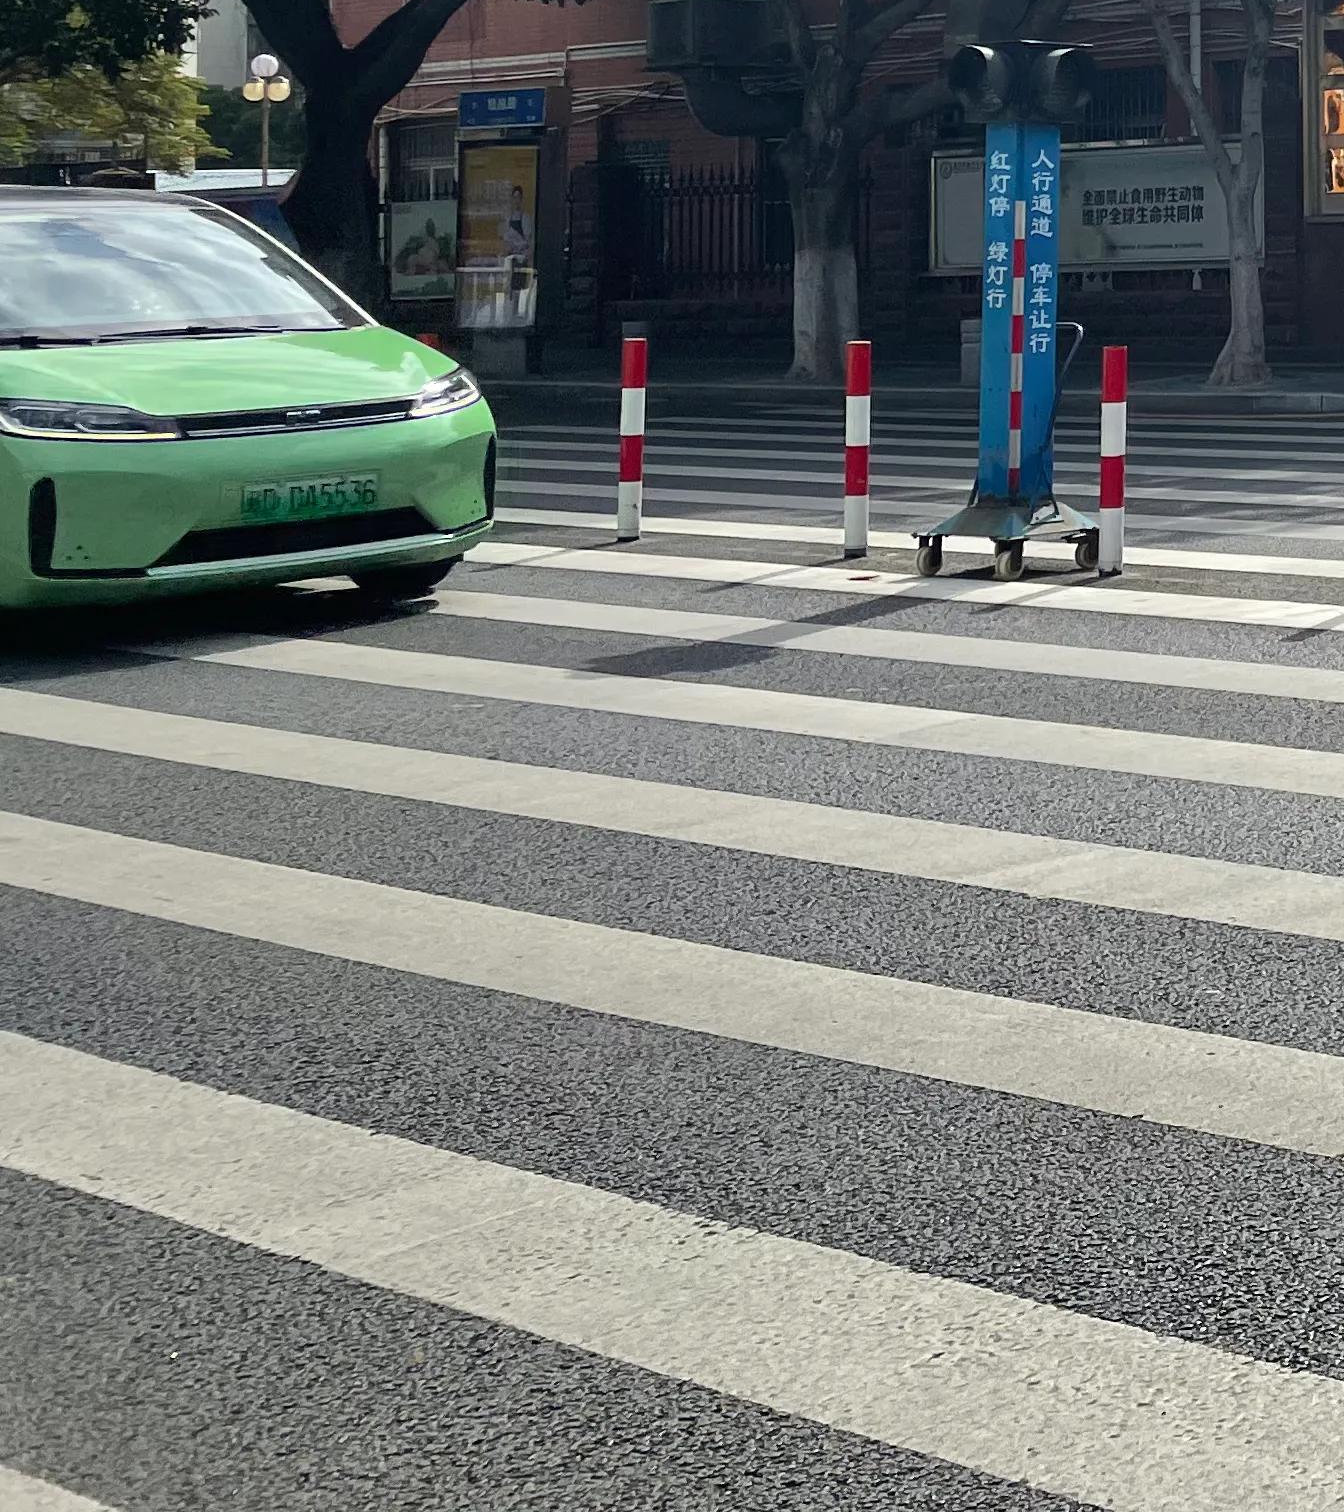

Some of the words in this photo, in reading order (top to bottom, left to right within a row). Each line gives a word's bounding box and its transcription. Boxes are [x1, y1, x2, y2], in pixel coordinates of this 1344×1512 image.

[989, 150, 1011, 217] 红灯停
[1030, 149, 1055, 238] 人行通道
[1082, 186, 1204, 206] 全面禁止食用野生动物
[1082, 204, 1204, 226] 维护全球生命共同体
[986, 241, 1009, 309] 绿灯行
[1029, 262, 1053, 354] 停车让行
